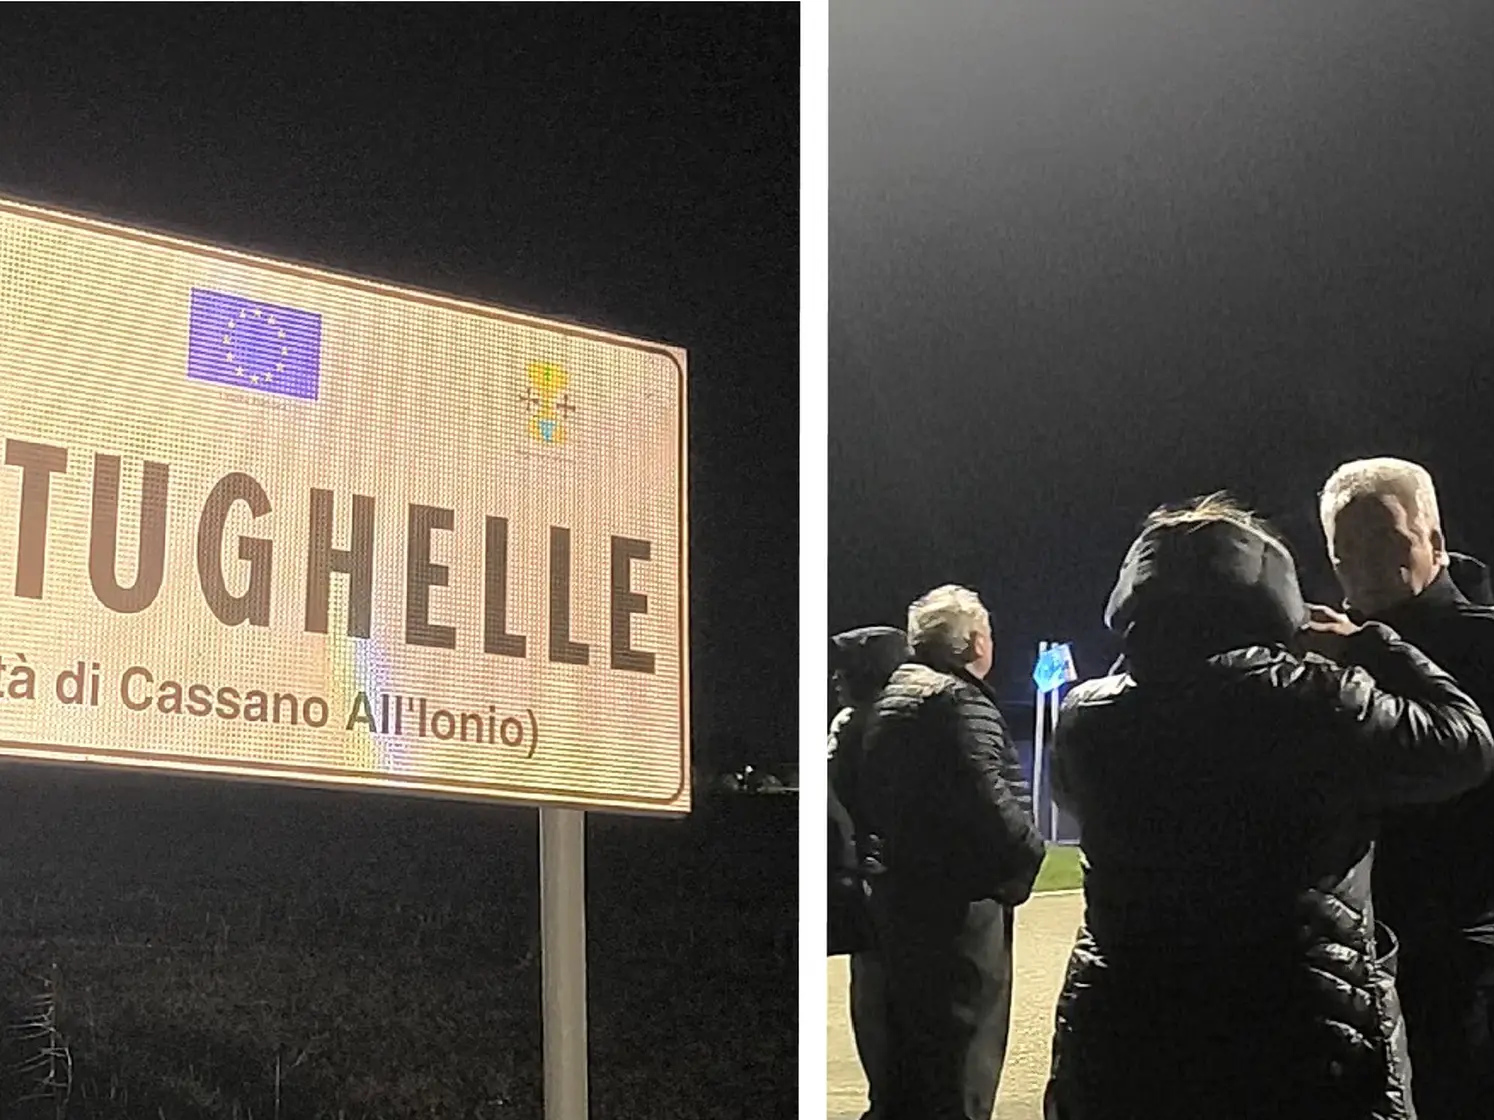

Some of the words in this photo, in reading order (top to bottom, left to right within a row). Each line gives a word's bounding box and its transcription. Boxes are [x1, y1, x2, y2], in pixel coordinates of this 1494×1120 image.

[4, 438, 656, 676] TUGHELLE
[55, 661, 101, 707] di
[119, 665, 330, 730] Cassano
[346, 690, 540, 758] All'Ionio)
